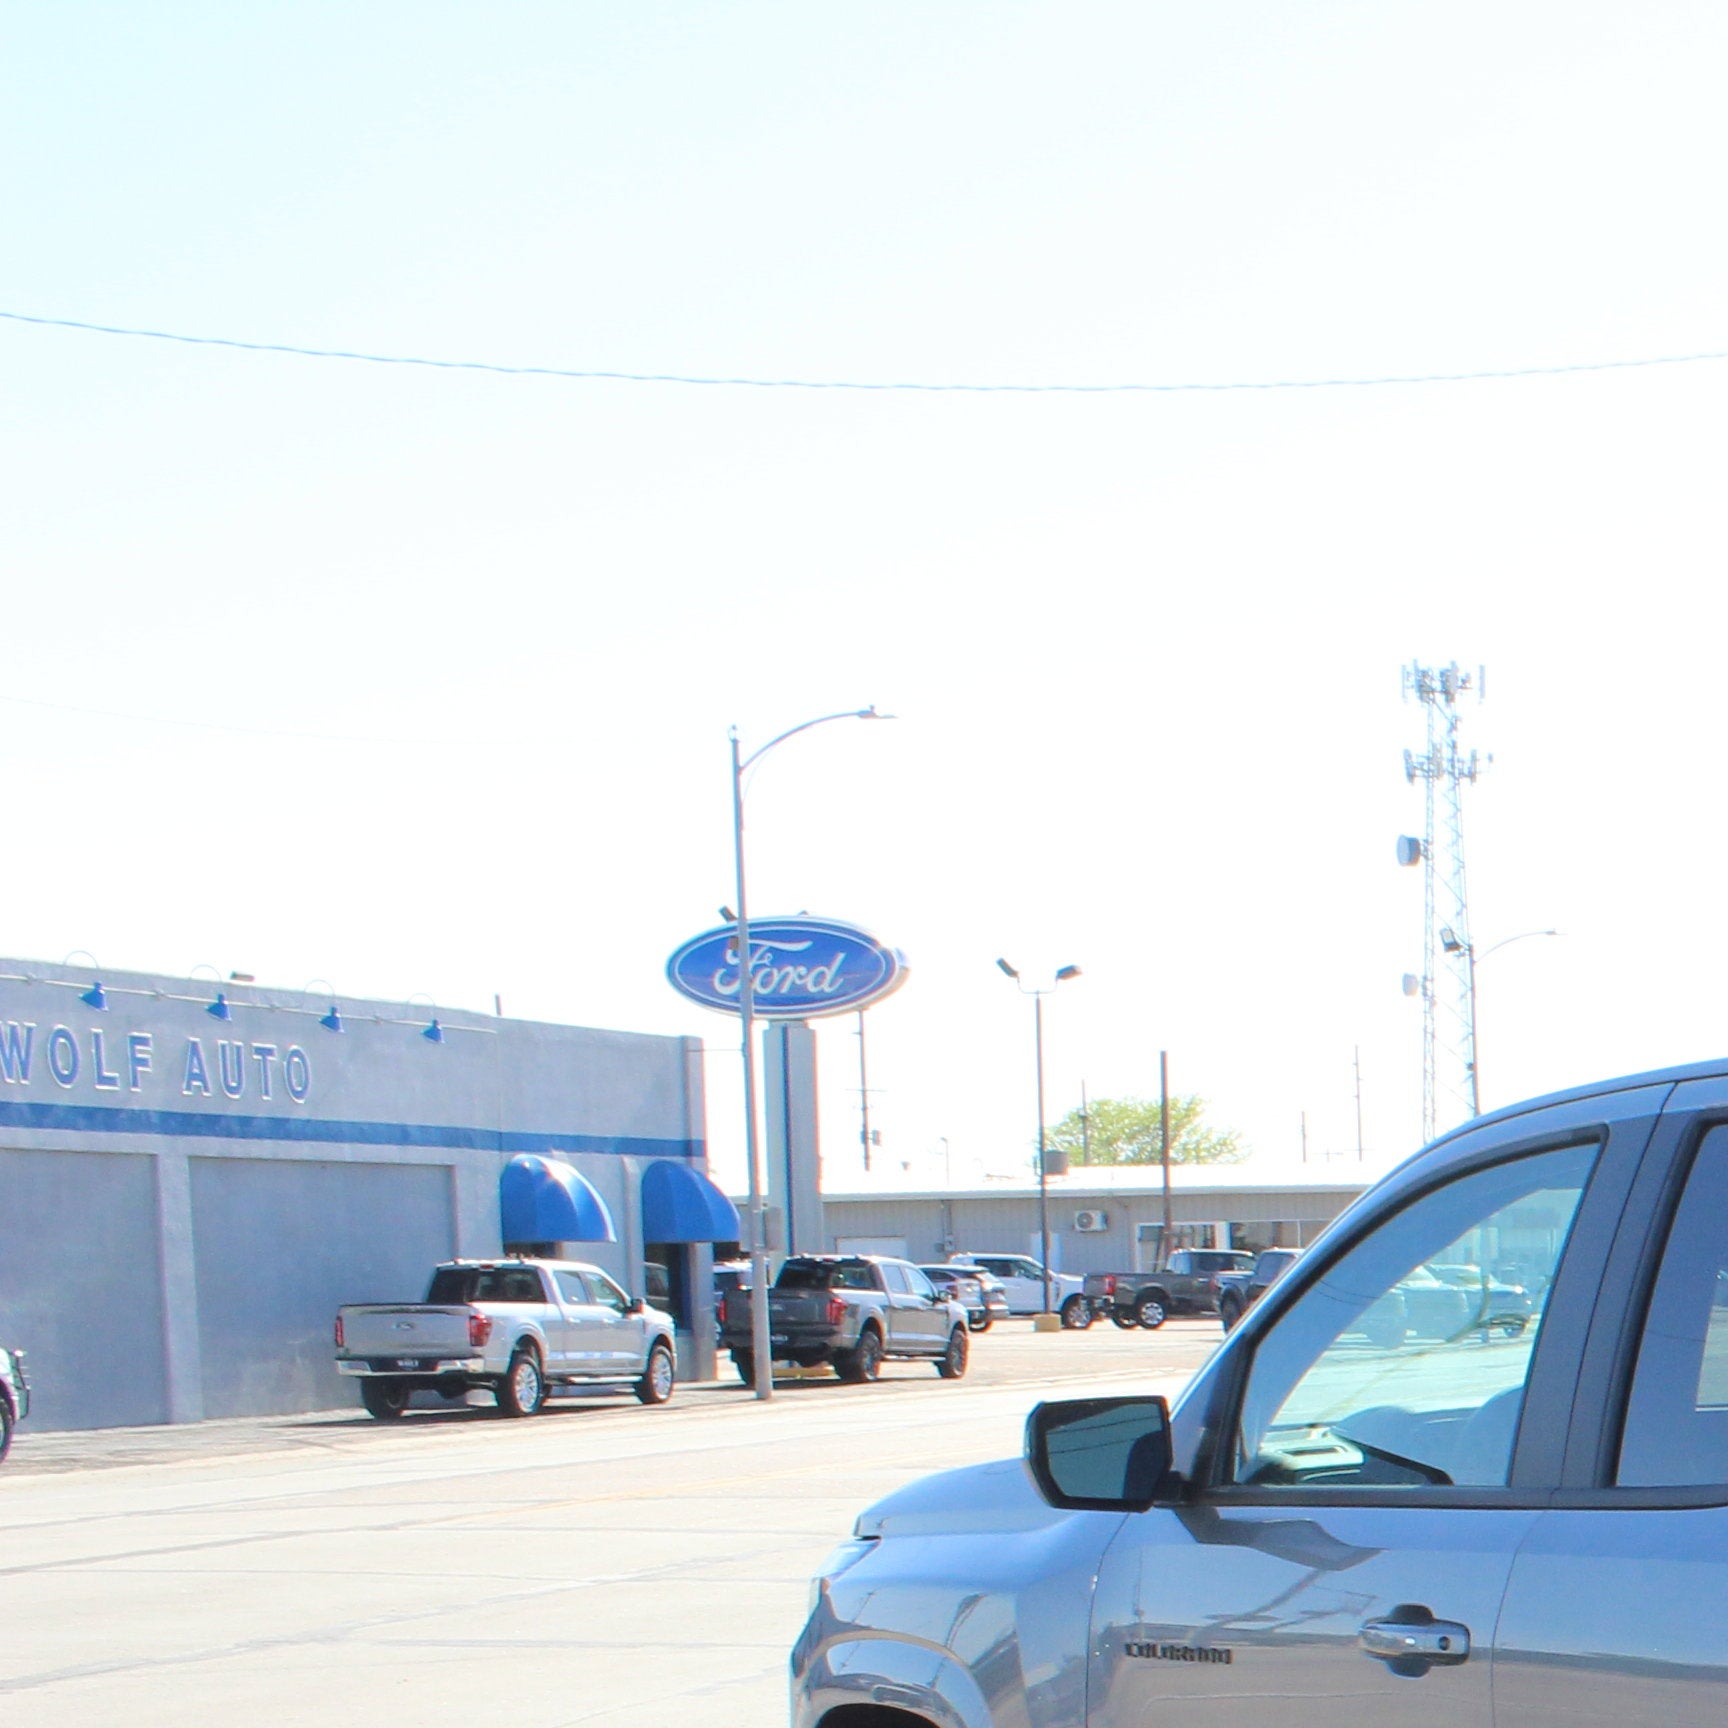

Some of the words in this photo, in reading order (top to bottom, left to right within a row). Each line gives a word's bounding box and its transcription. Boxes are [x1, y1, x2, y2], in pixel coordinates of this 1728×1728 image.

[712, 938, 846, 995] Ford
[0, 1020, 153, 1092] WOLF
[182, 1037, 312, 1104] AUTO
